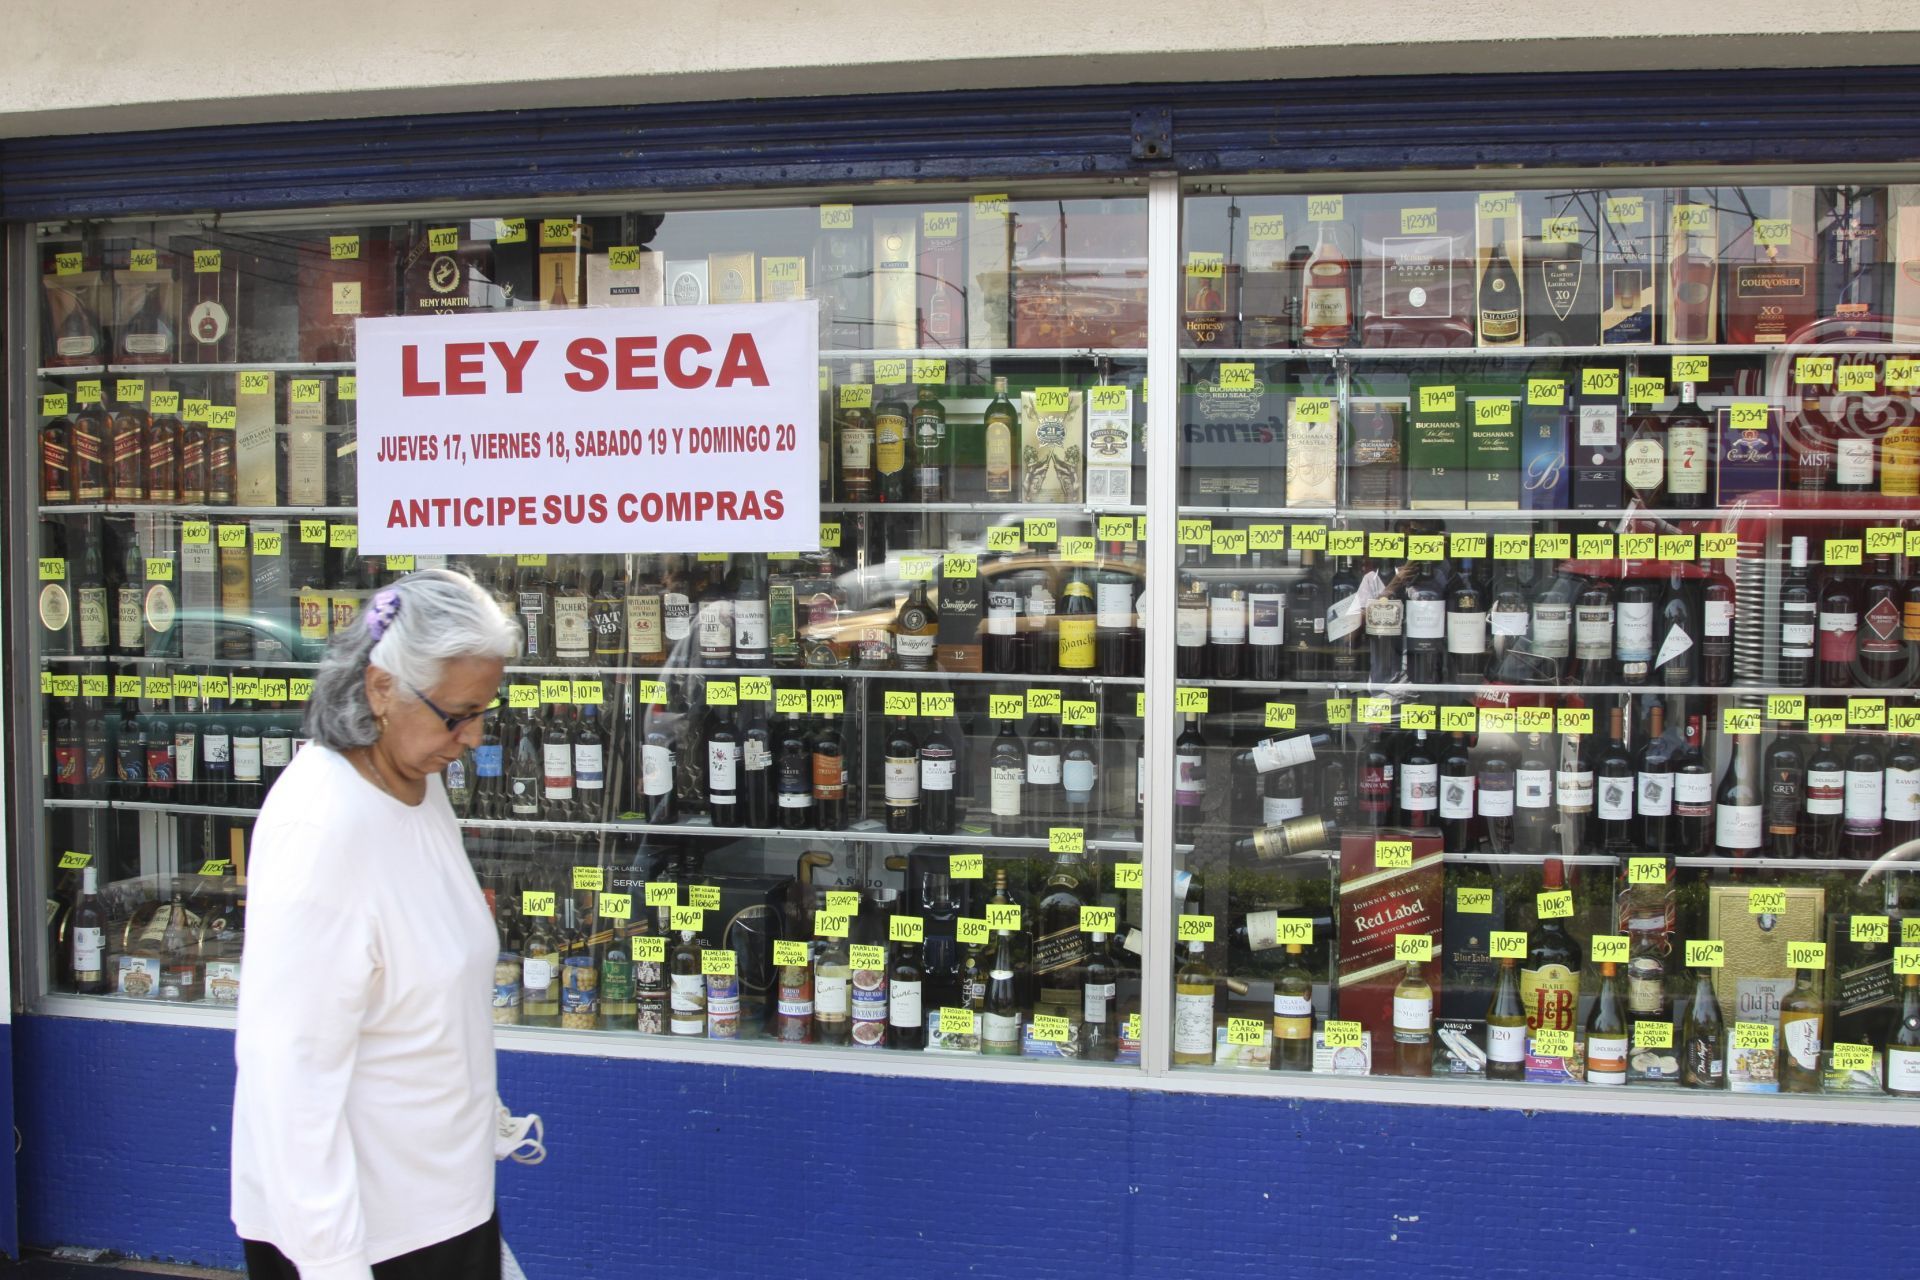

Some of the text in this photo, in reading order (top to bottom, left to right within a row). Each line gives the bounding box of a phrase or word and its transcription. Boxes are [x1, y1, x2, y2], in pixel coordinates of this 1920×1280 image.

[1741, 278, 1801, 288] COURVOISIER
[1556, 290, 1570, 300] XO
[441, 297, 469, 308] MARTIN
[1762, 306, 1782, 315] XO
[1187, 321, 1225, 336] Hennessy
[402, 333, 770, 396] LEY SECA
[377, 424, 797, 465] JUEVES 17, VIERNES 18, SABADO 19 Y DOMINGO 20
[387, 490, 784, 528] ANTICIPE SUS COMPRAS
[594, 612, 622, 626] VAT
[599, 623, 617, 635] 69
[955, 651, 964, 660] 12
[613, 880, 645, 888] SERVE
[1353, 884, 1420, 912] JOHNNIE WALKER
[1355, 898, 1425, 932] Red Label
[1352, 915, 1431, 945] BLENDED SCOTCH WHISKY
[634, 937, 662, 945] FABADA
[853, 945, 879, 953] MARLIN
[1842, 986, 1866, 998] BLACK
[1866, 978, 1891, 990] LABEL
[1741, 991, 1762, 1013] Old
[1232, 1019, 1263, 1027] ATUN
[1443, 1021, 1473, 1031] NAVAJAS
[1636, 1022, 1667, 1030] ALMEJAS
[1737, 1023, 1768, 1031] ENSALADA
[1230, 1026, 1256, 1034] CLARO
[1326, 1027, 1358, 1035] ANGULAS
[1539, 1030, 1569, 1038] PULPO
[1746, 1030, 1769, 1038] ATUN
[1490, 1030, 1511, 1042] 120
[1836, 1045, 1872, 1055] SARDINAS
